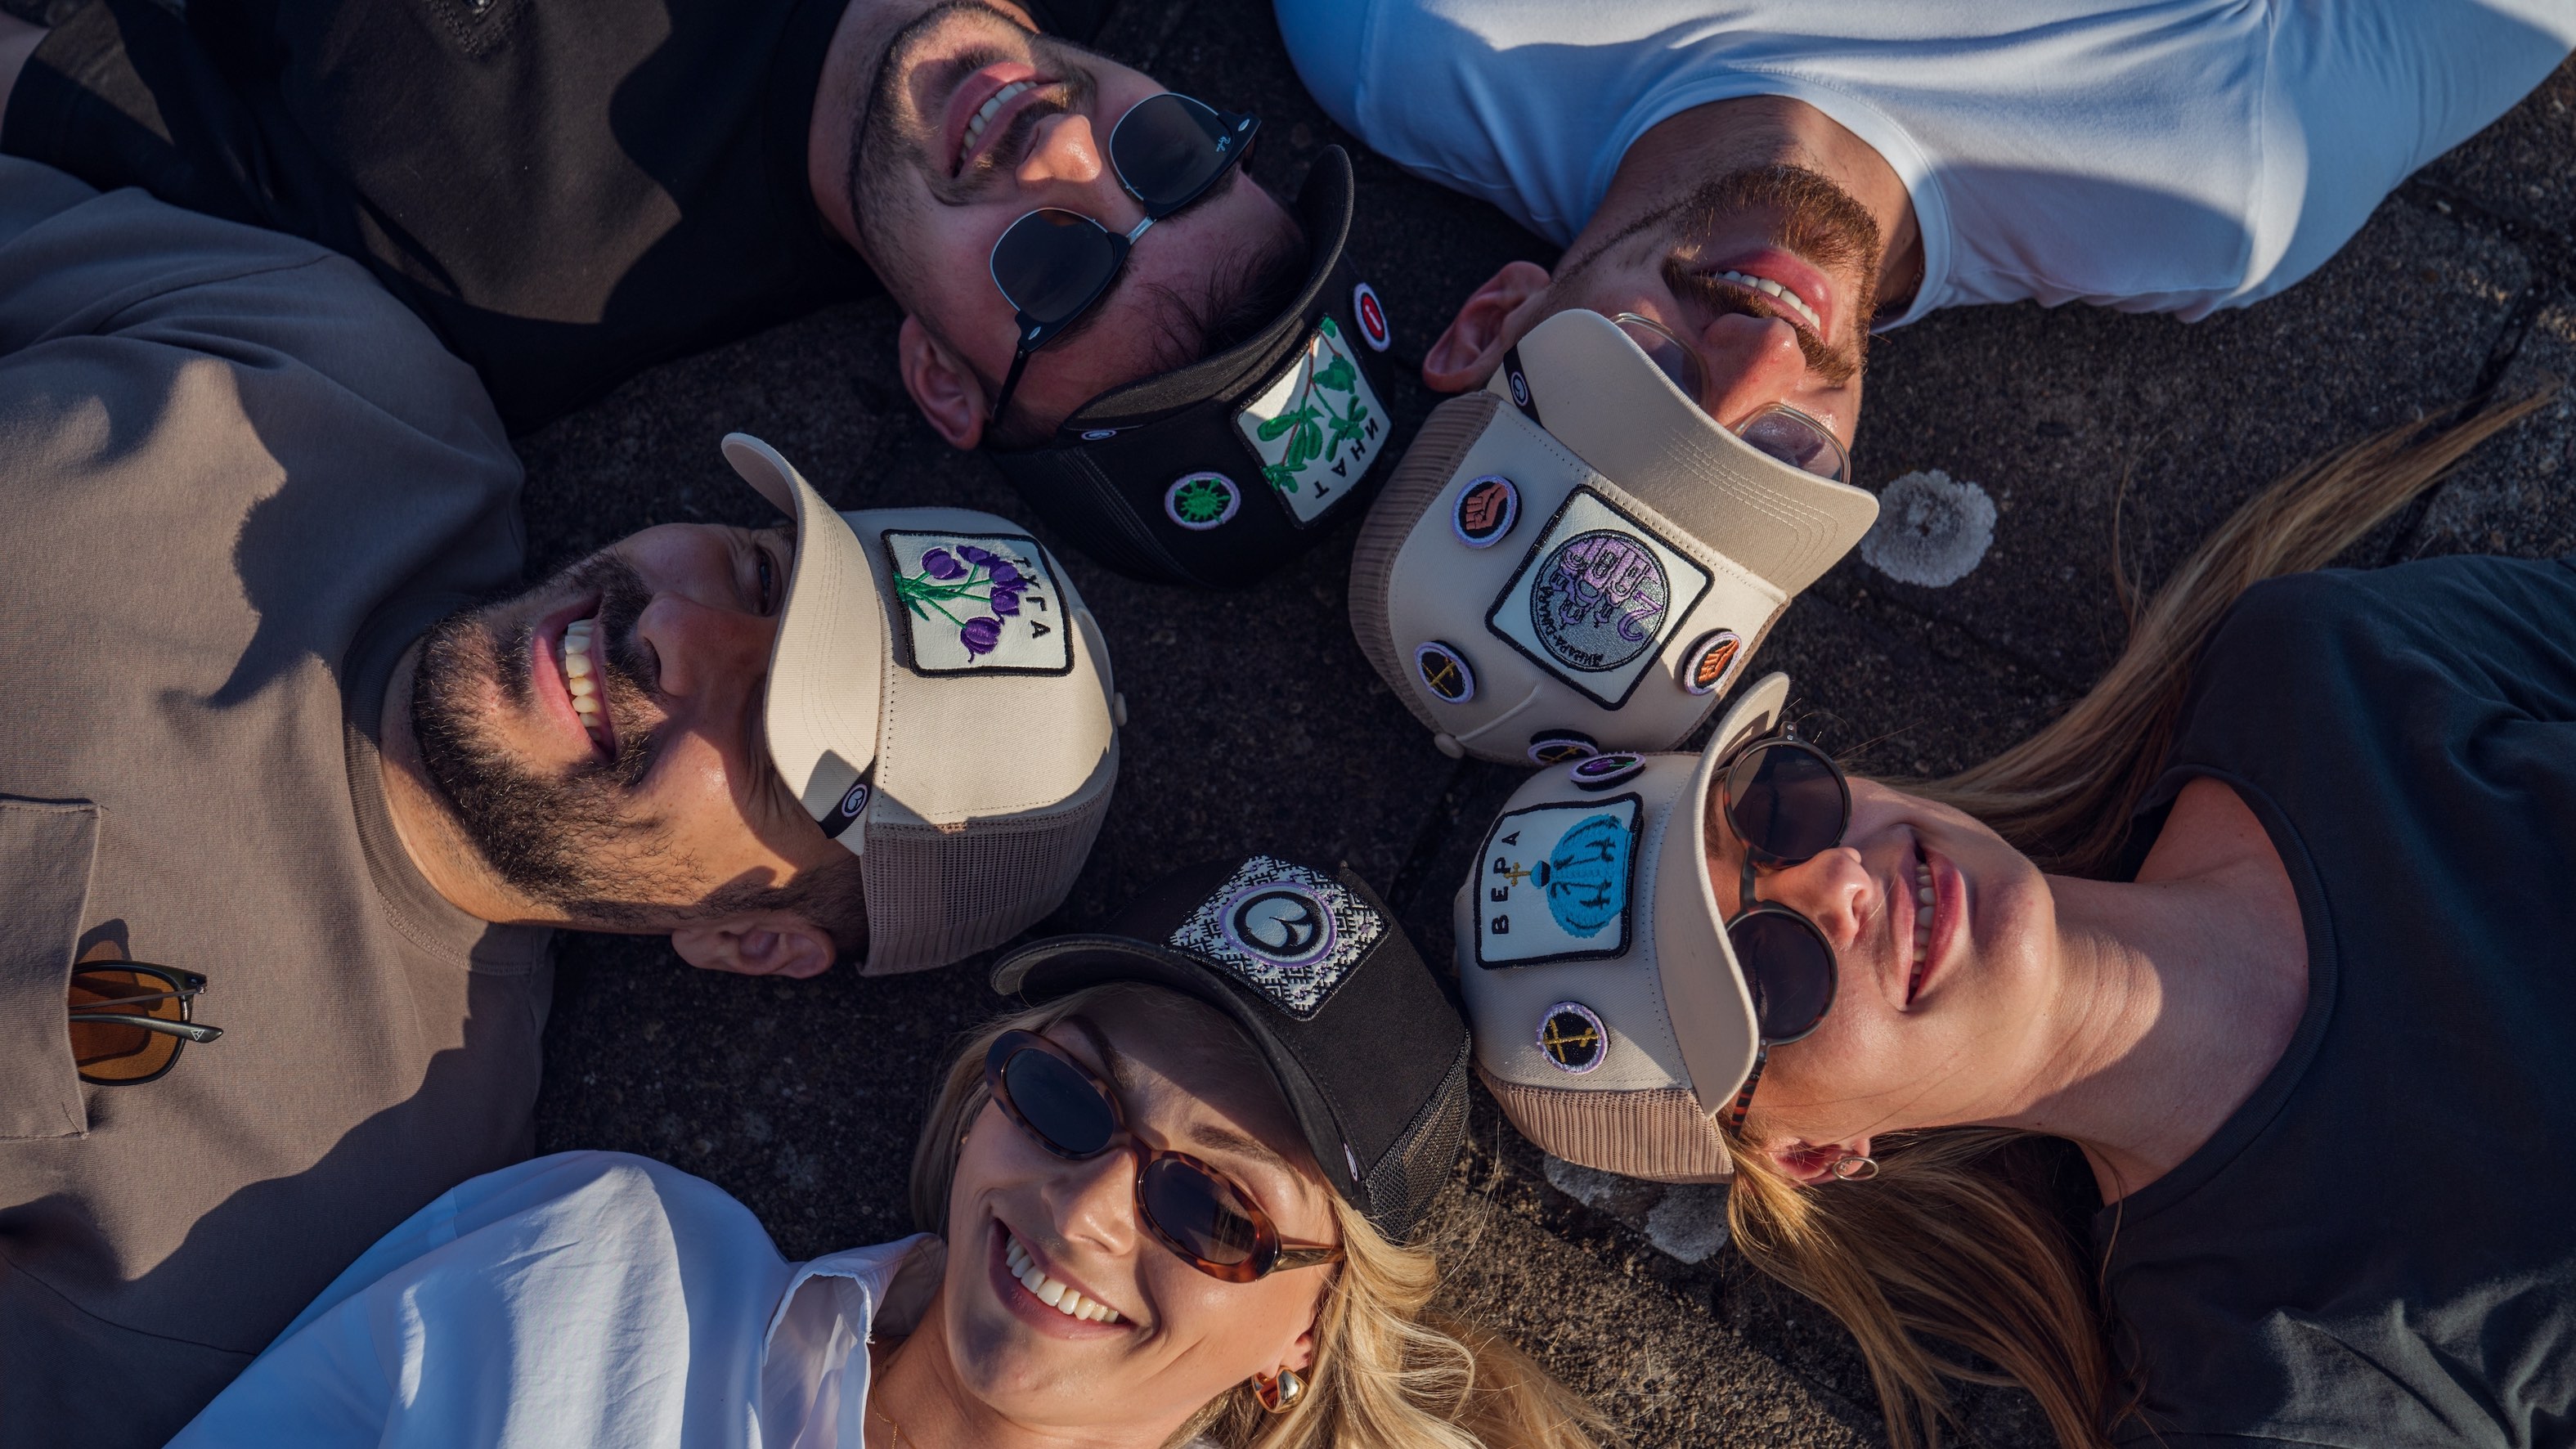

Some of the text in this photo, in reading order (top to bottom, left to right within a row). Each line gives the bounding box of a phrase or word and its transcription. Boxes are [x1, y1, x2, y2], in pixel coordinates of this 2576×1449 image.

[1313, 418, 1380, 500] ИНАТ
[1012, 556, 1051, 639] ТУГА
[1617, 590, 1663, 642] 2
[1491, 830, 1521, 935] ВЕРА
